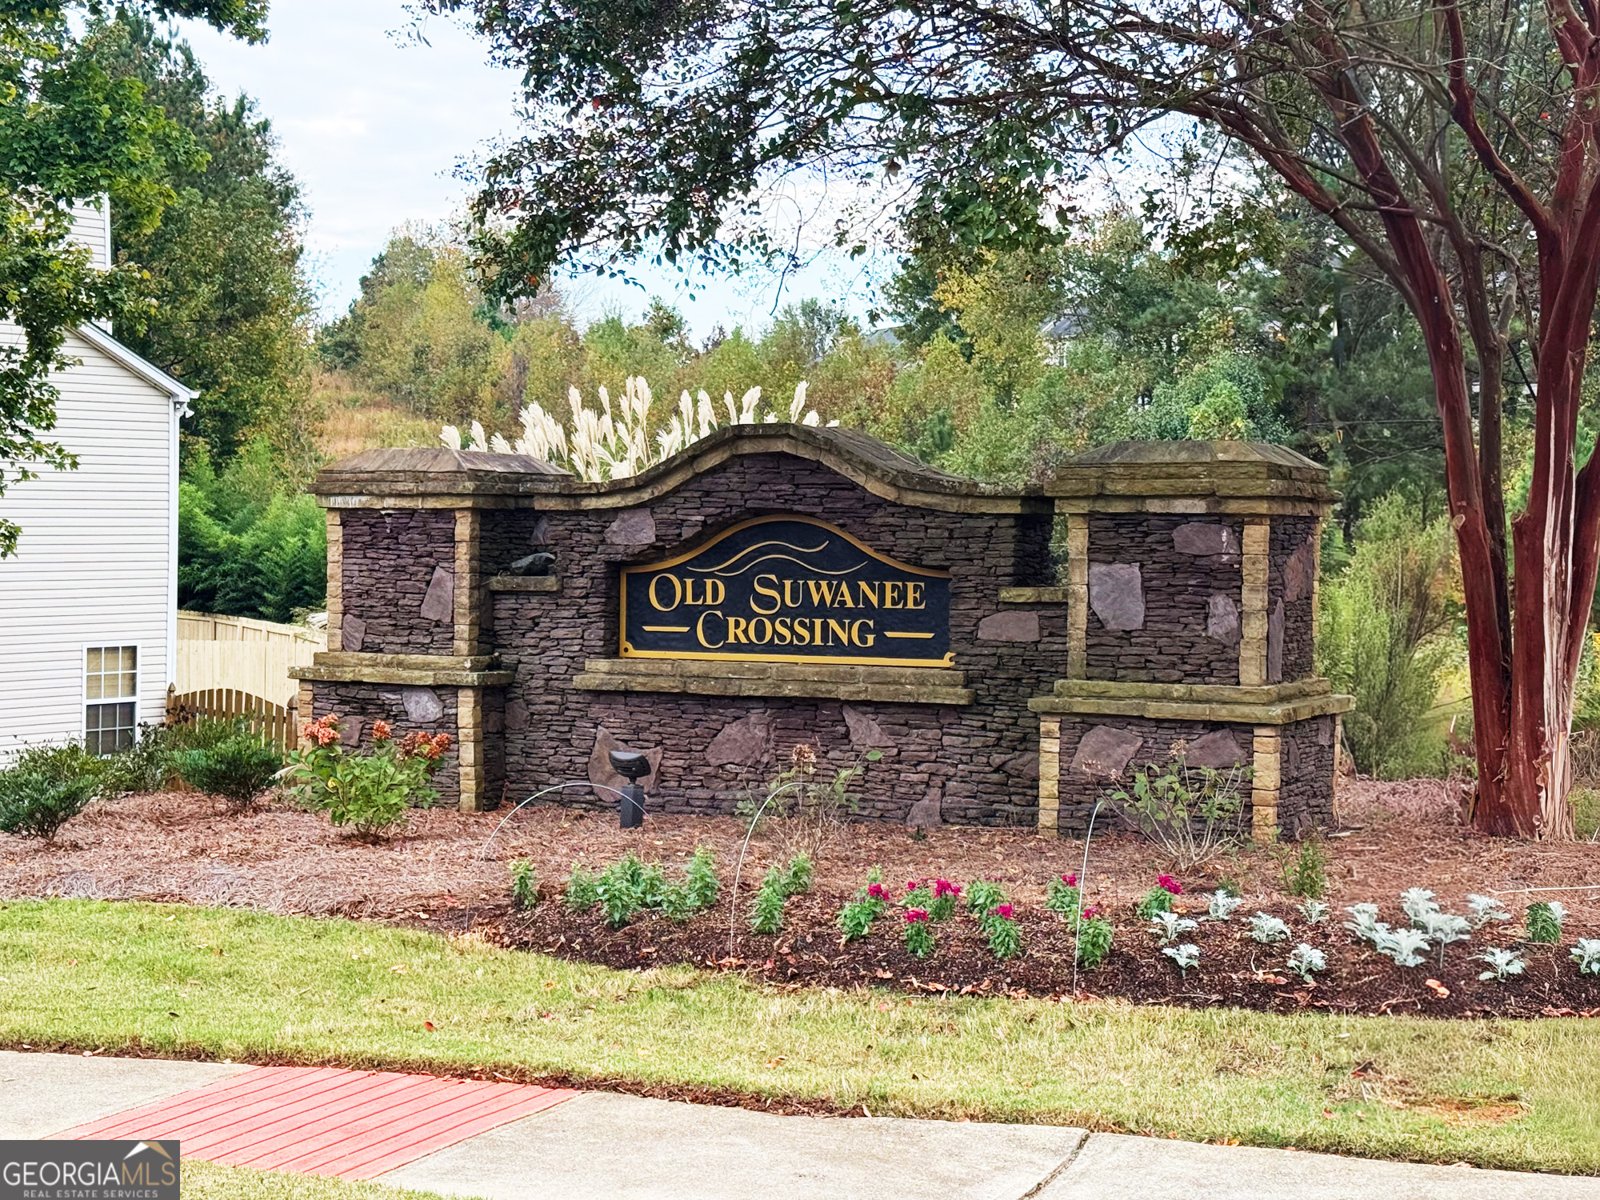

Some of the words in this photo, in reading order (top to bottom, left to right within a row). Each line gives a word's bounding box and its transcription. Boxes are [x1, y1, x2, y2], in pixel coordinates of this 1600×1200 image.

[649, 573, 726, 612] OLD
[750, 574, 926, 615] SUWANEE
[696, 610, 876, 648] CROSSING
